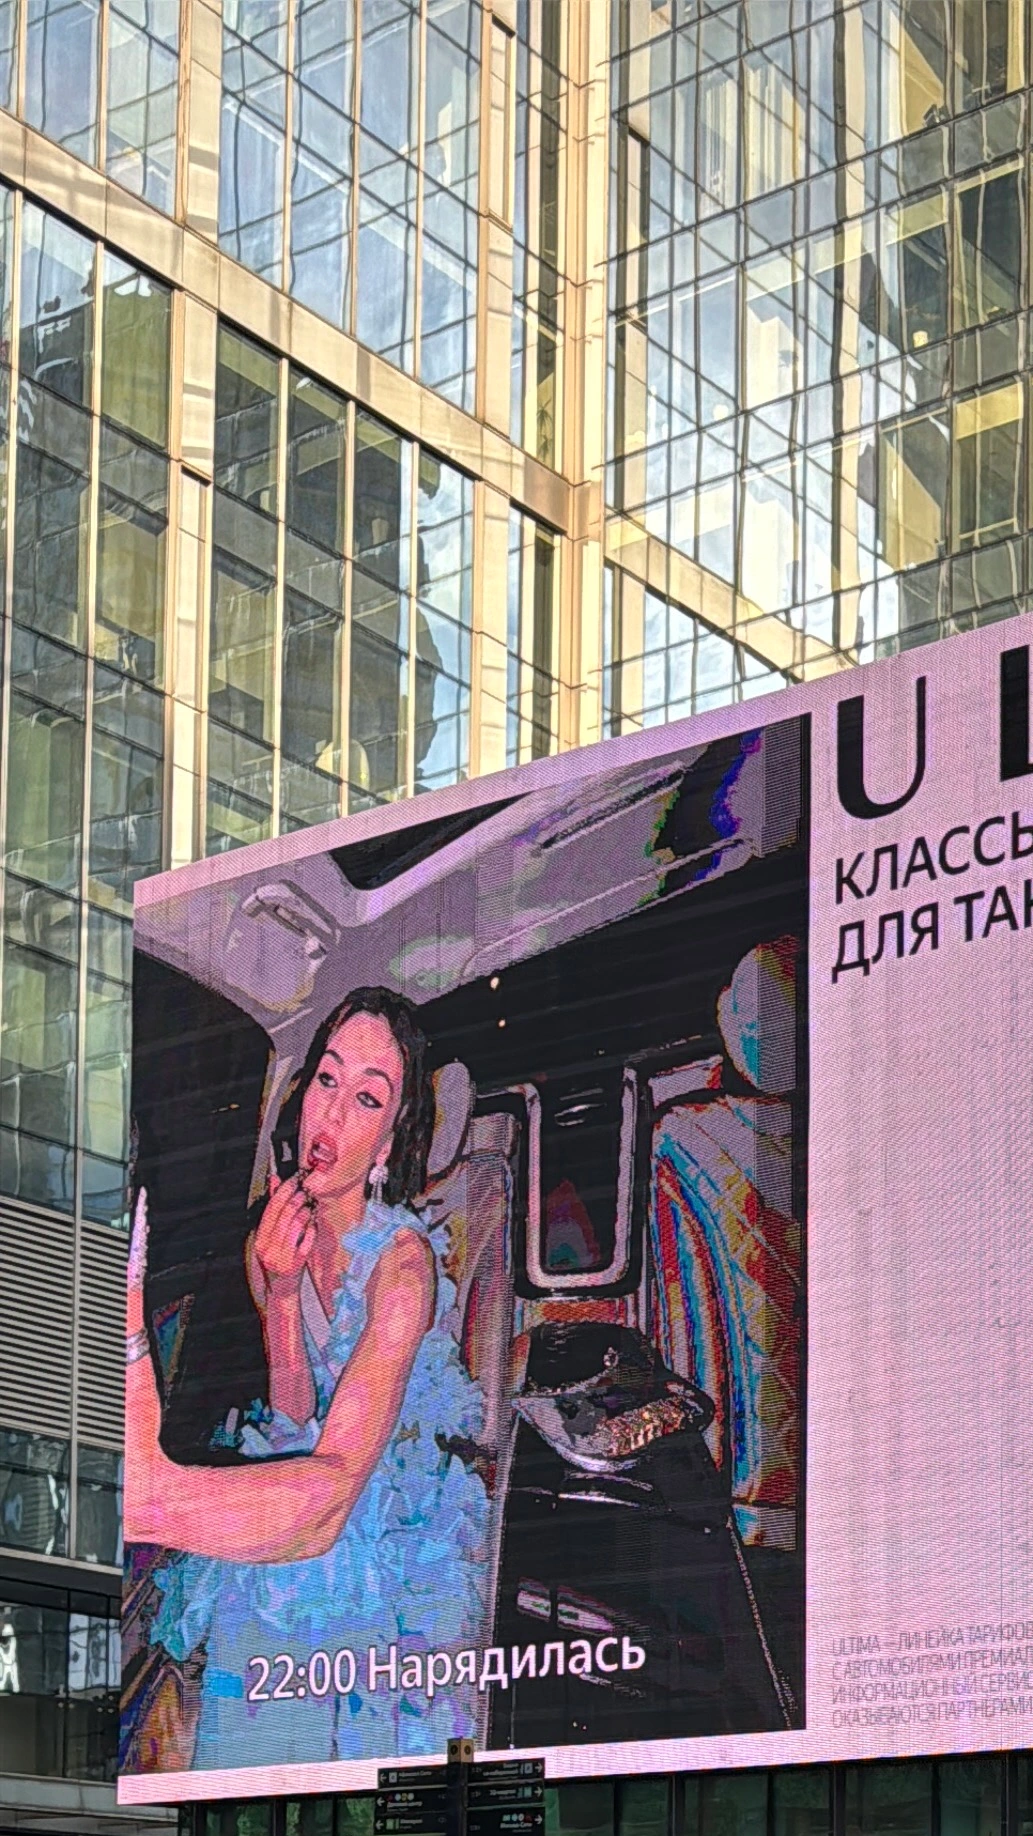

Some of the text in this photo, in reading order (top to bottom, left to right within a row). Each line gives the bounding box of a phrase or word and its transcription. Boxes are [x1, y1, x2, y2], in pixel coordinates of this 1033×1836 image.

[832, 902, 939, 983] ДЛЯ
[247, 1636, 648, 1701] 22:00 Нарядилась
